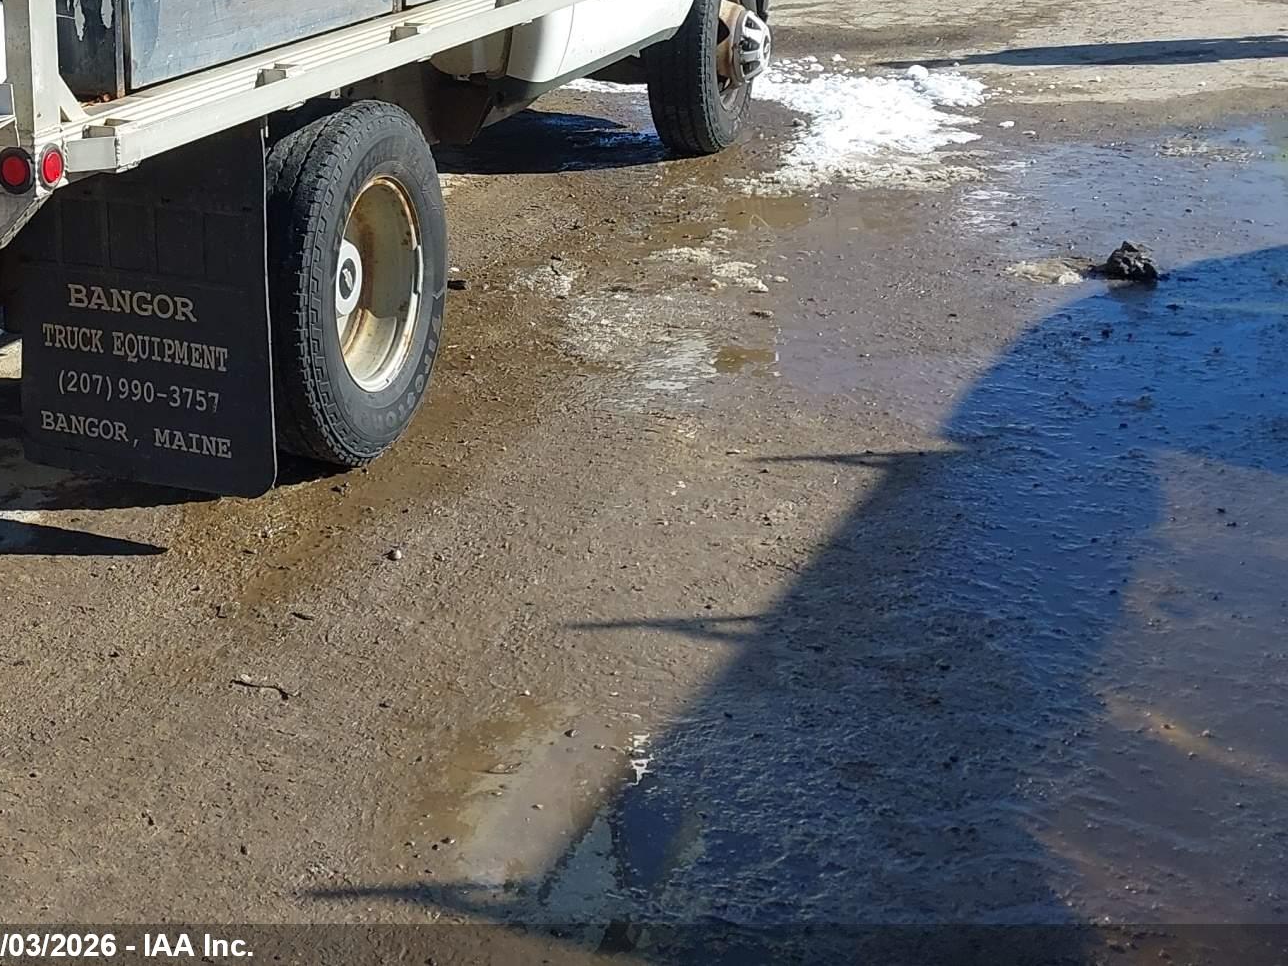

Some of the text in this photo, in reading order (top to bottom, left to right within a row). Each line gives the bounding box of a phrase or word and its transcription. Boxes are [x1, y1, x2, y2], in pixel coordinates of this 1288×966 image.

[67, 284, 197, 322] BANGOR
[42, 323, 228, 371] TRUCK EQUIPMENT
[40, 410, 232, 458] BANGOR, MAINE
